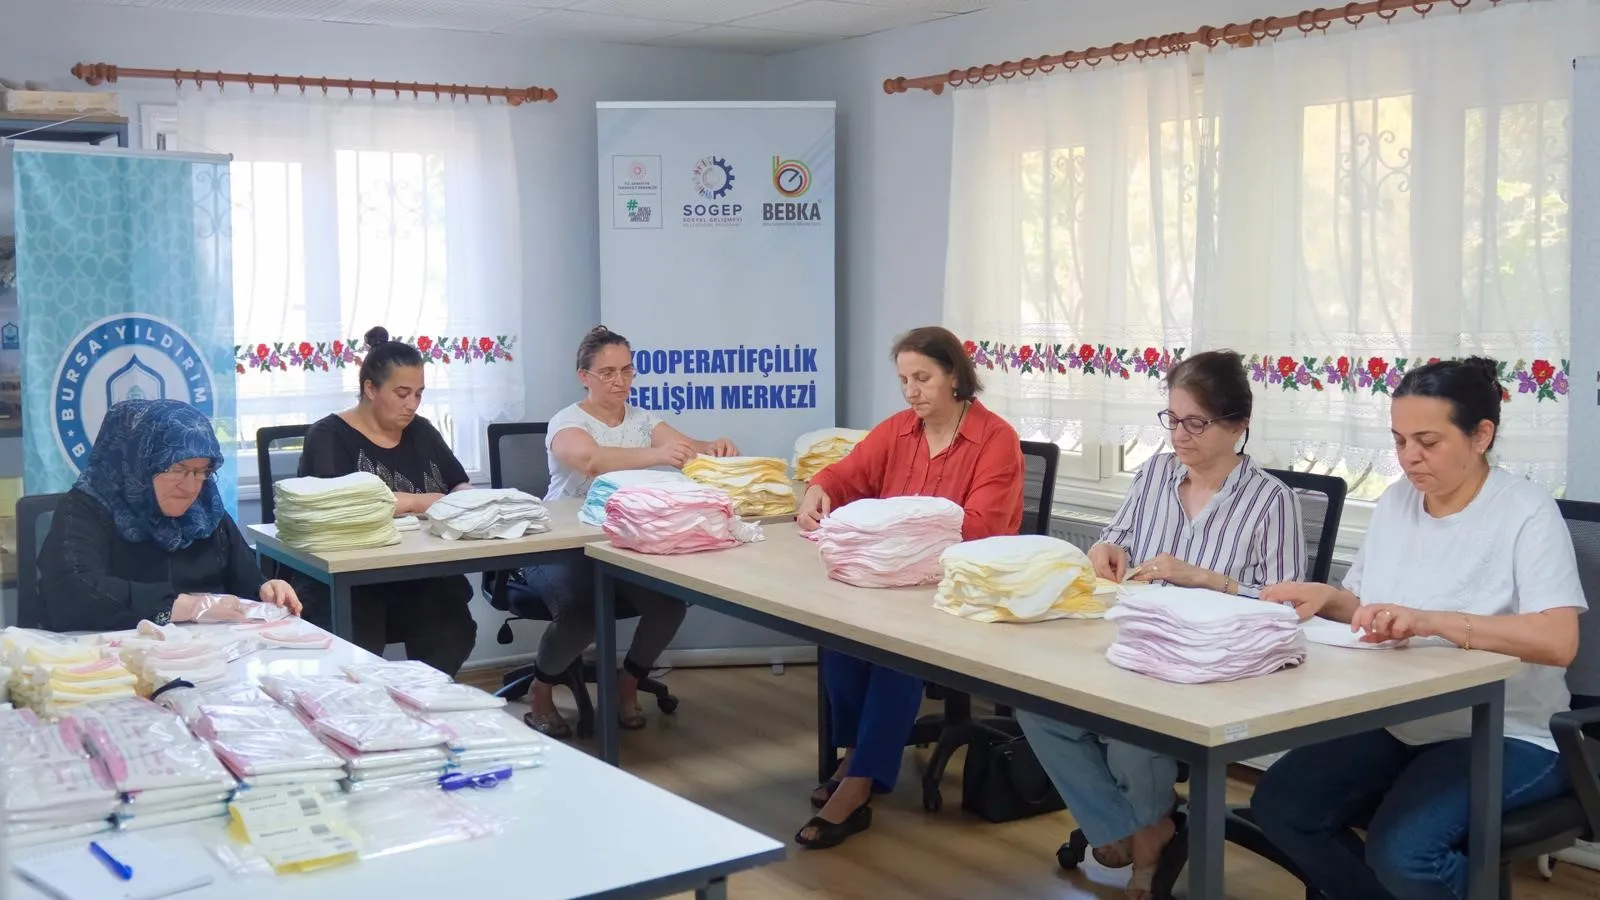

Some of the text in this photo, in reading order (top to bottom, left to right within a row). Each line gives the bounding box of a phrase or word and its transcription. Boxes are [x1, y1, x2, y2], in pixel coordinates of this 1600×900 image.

[683, 204, 743, 216] SOGEP
[763, 202, 821, 220] BEBKA
[61, 325, 207, 421] BURSA YILDIRIM
[631, 344, 818, 377] OOPERATİFÇİLİK
[721, 380, 816, 409] MERKEZİ
